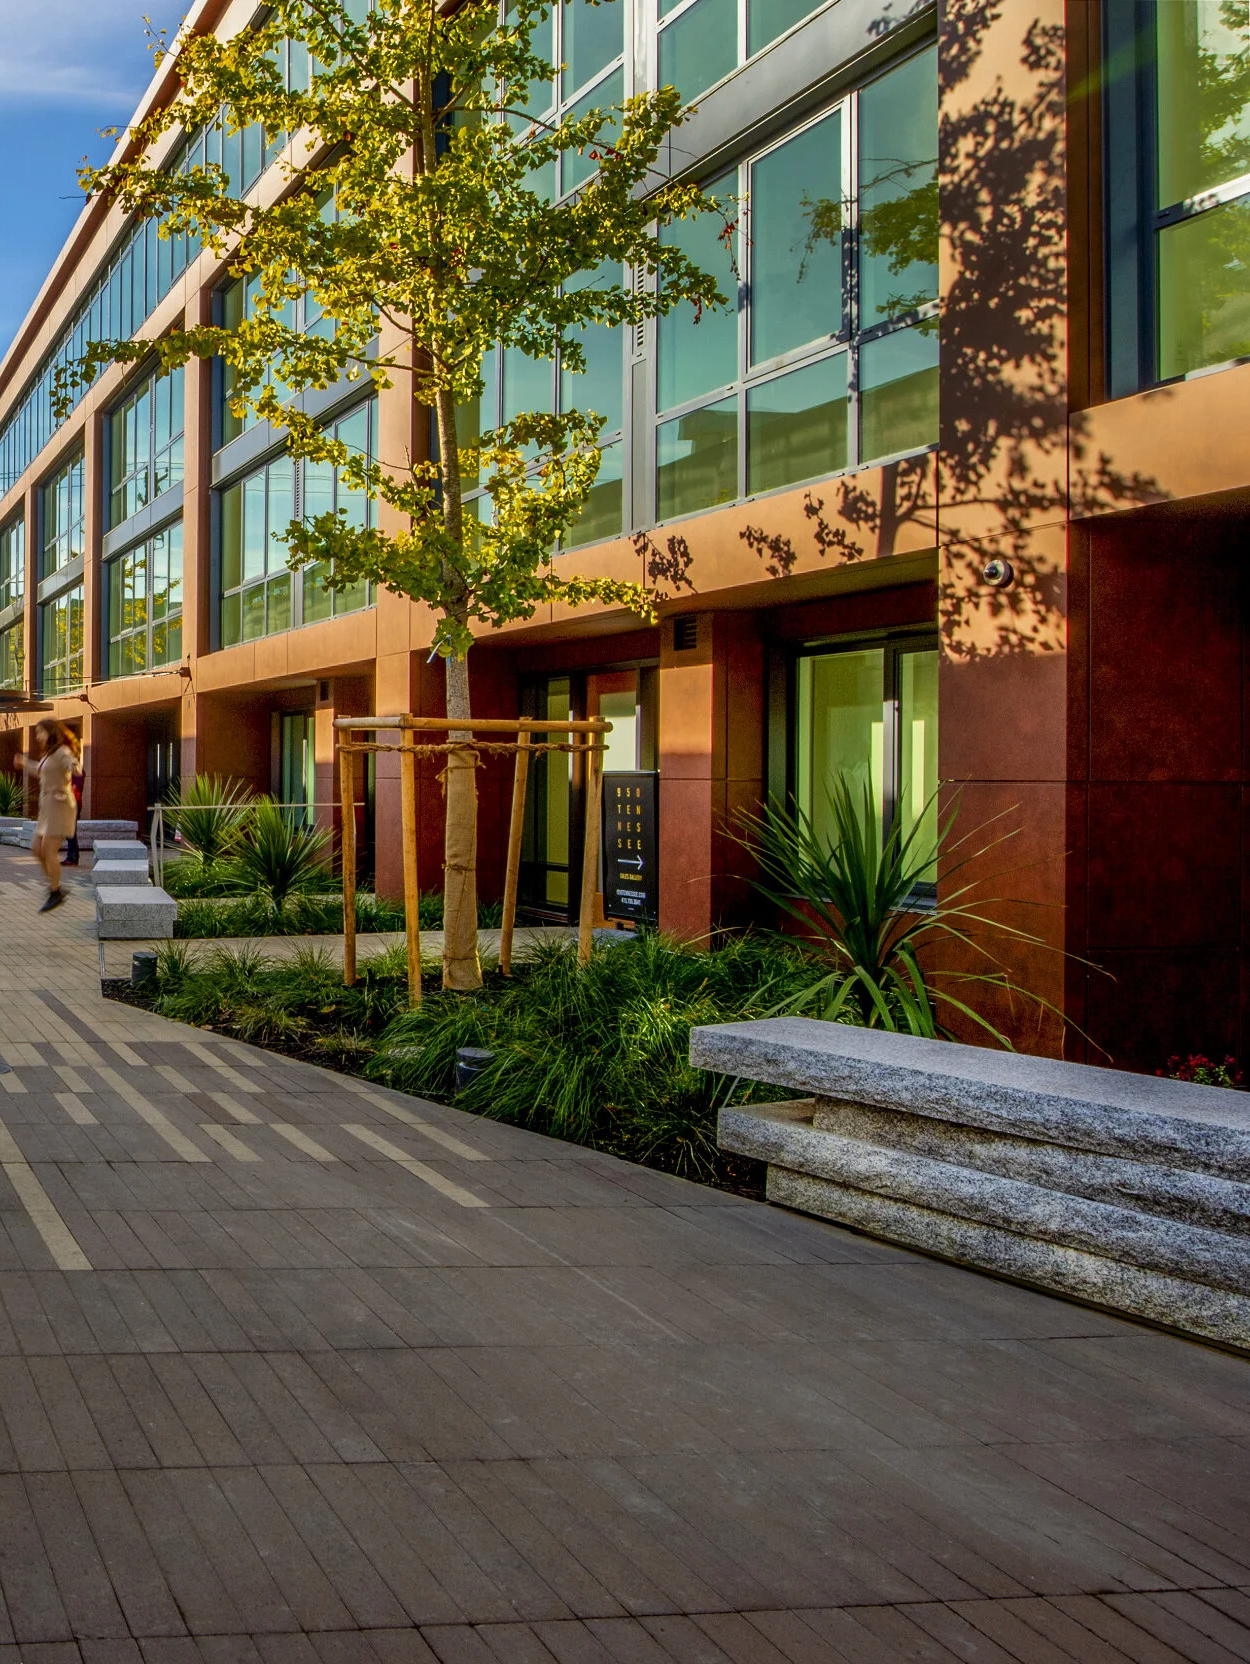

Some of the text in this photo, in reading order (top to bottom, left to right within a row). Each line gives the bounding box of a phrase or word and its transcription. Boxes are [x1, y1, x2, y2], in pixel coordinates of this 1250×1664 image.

[616, 787, 641, 798] 950
[617, 804, 641, 815] TEN
[617, 821, 641, 833] NES
[617, 838, 641, 850] SEE
